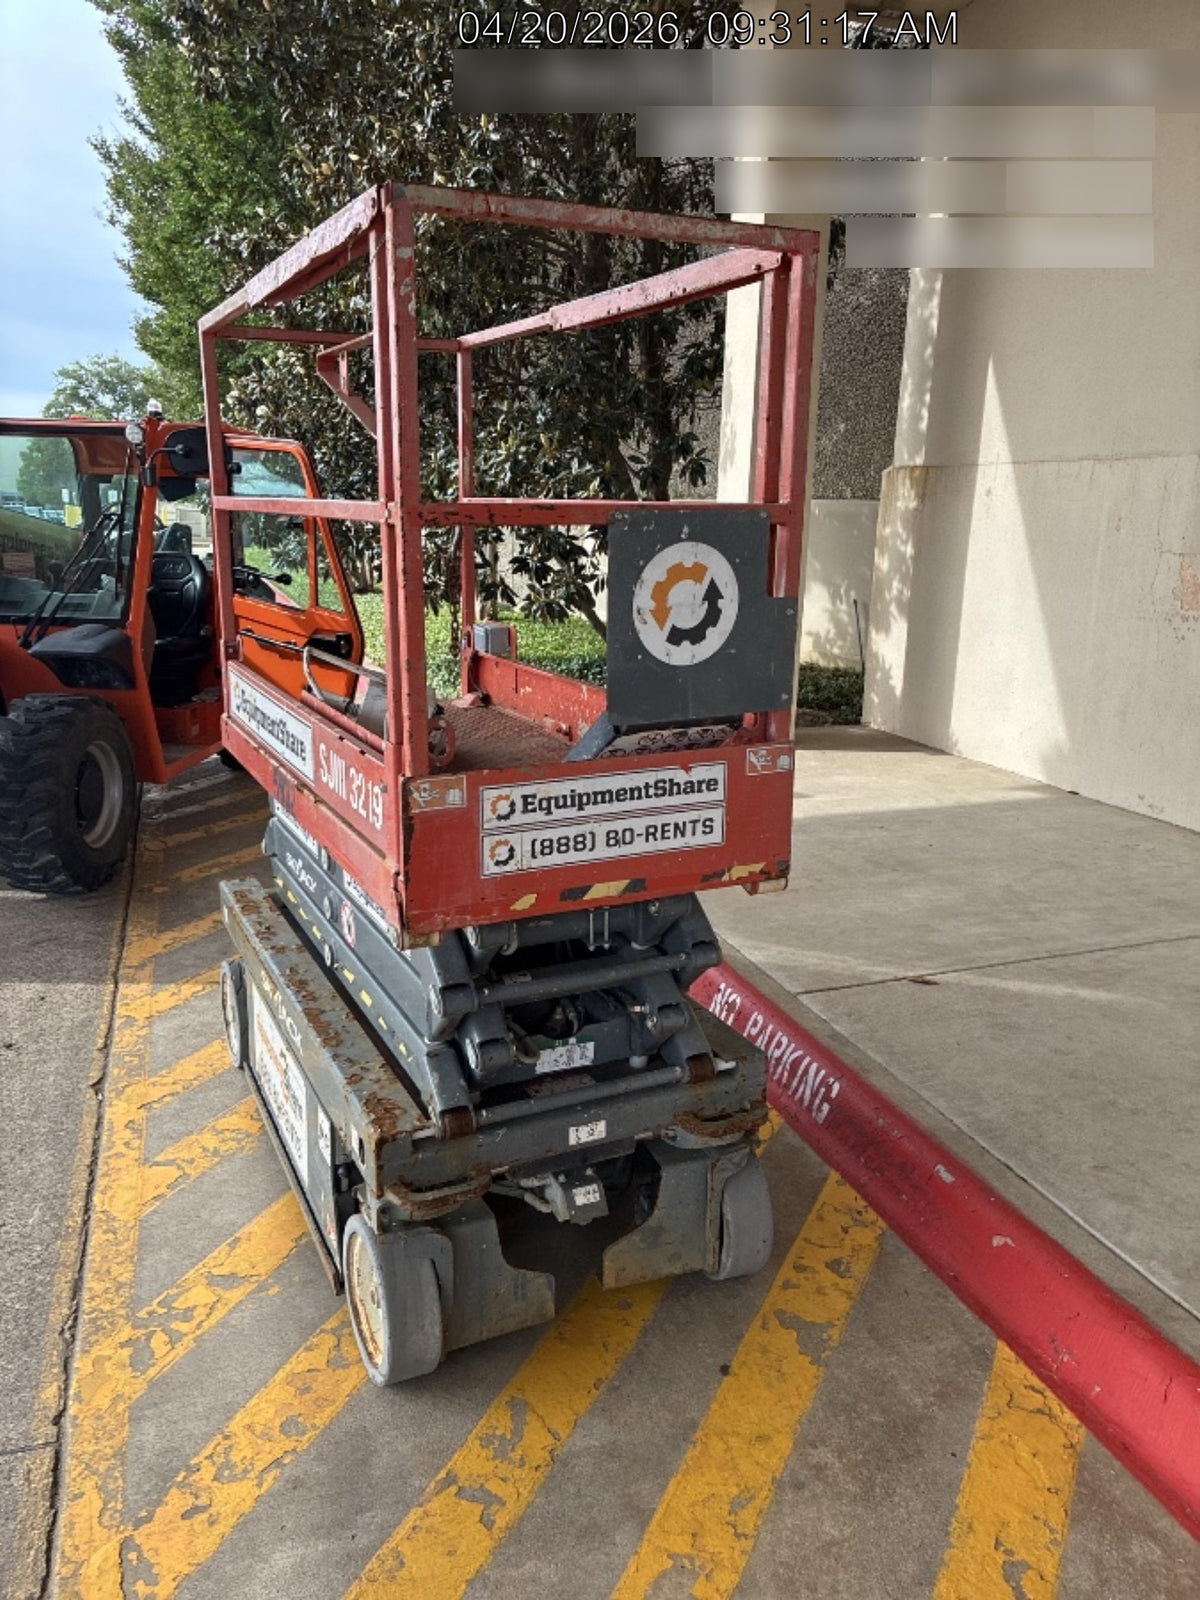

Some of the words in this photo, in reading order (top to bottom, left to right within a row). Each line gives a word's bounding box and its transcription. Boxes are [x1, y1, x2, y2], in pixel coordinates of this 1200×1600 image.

[350, 767, 383, 830] 3219
[520, 774, 719, 815] EquipmentShare
[530, 830, 597, 859] (888)
[605, 817, 715, 848] 80-RENTS
[709, 982, 741, 1026] NO
[743, 1011, 840, 1124] PARKING
